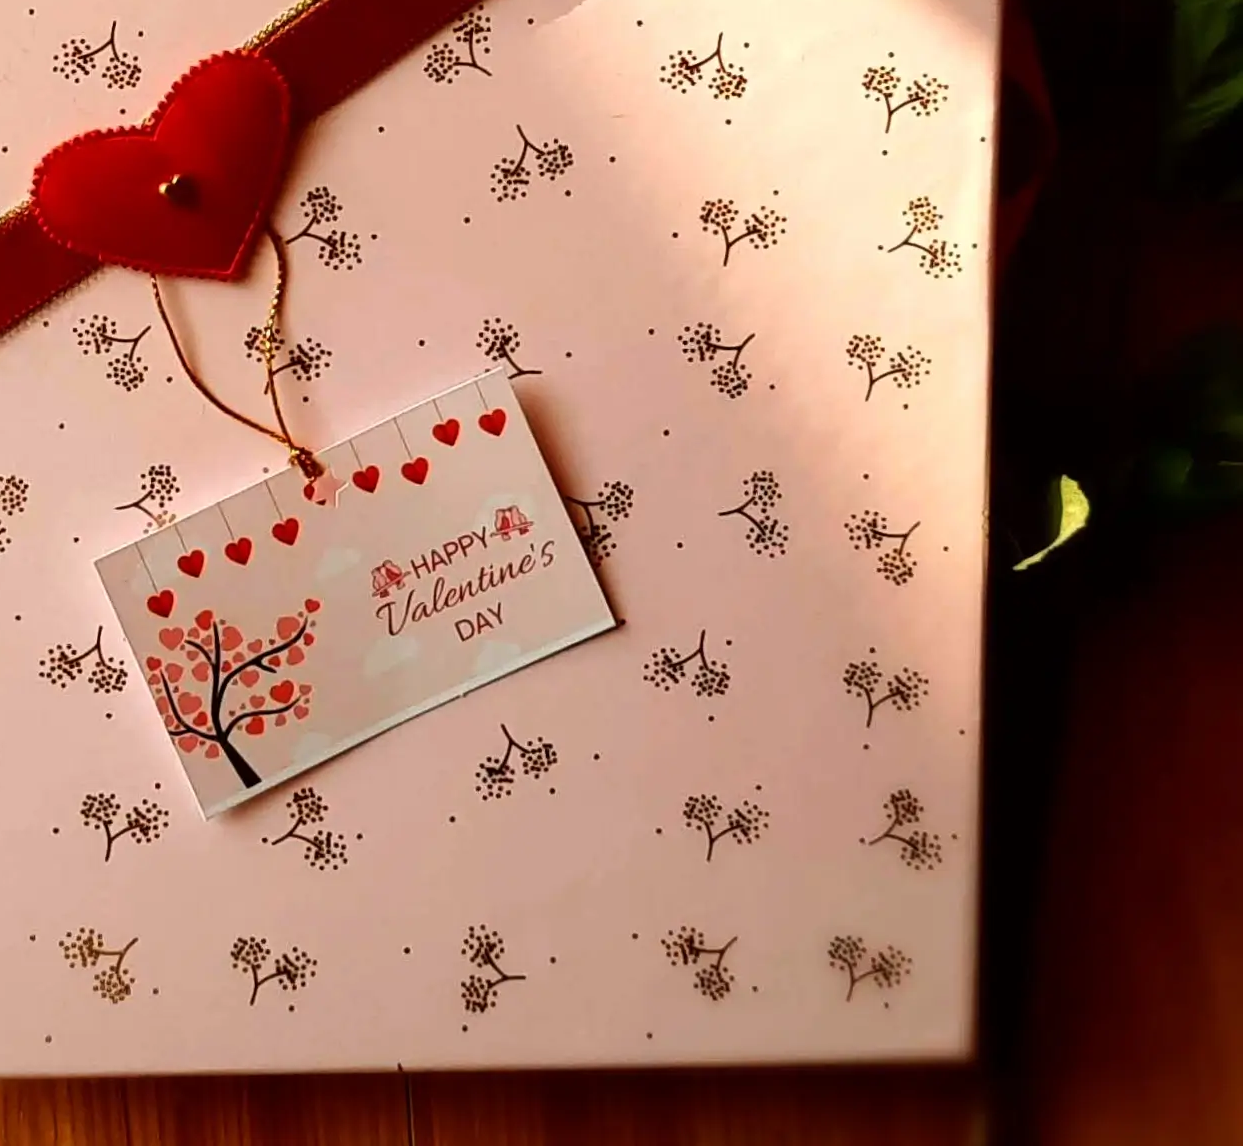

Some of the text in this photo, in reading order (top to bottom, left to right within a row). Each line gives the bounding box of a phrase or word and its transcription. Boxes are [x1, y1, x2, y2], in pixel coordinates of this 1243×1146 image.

[410, 525, 489, 579] HAPPY
[375, 539, 556, 637] Valentine's
[454, 602, 504, 642] DAY
